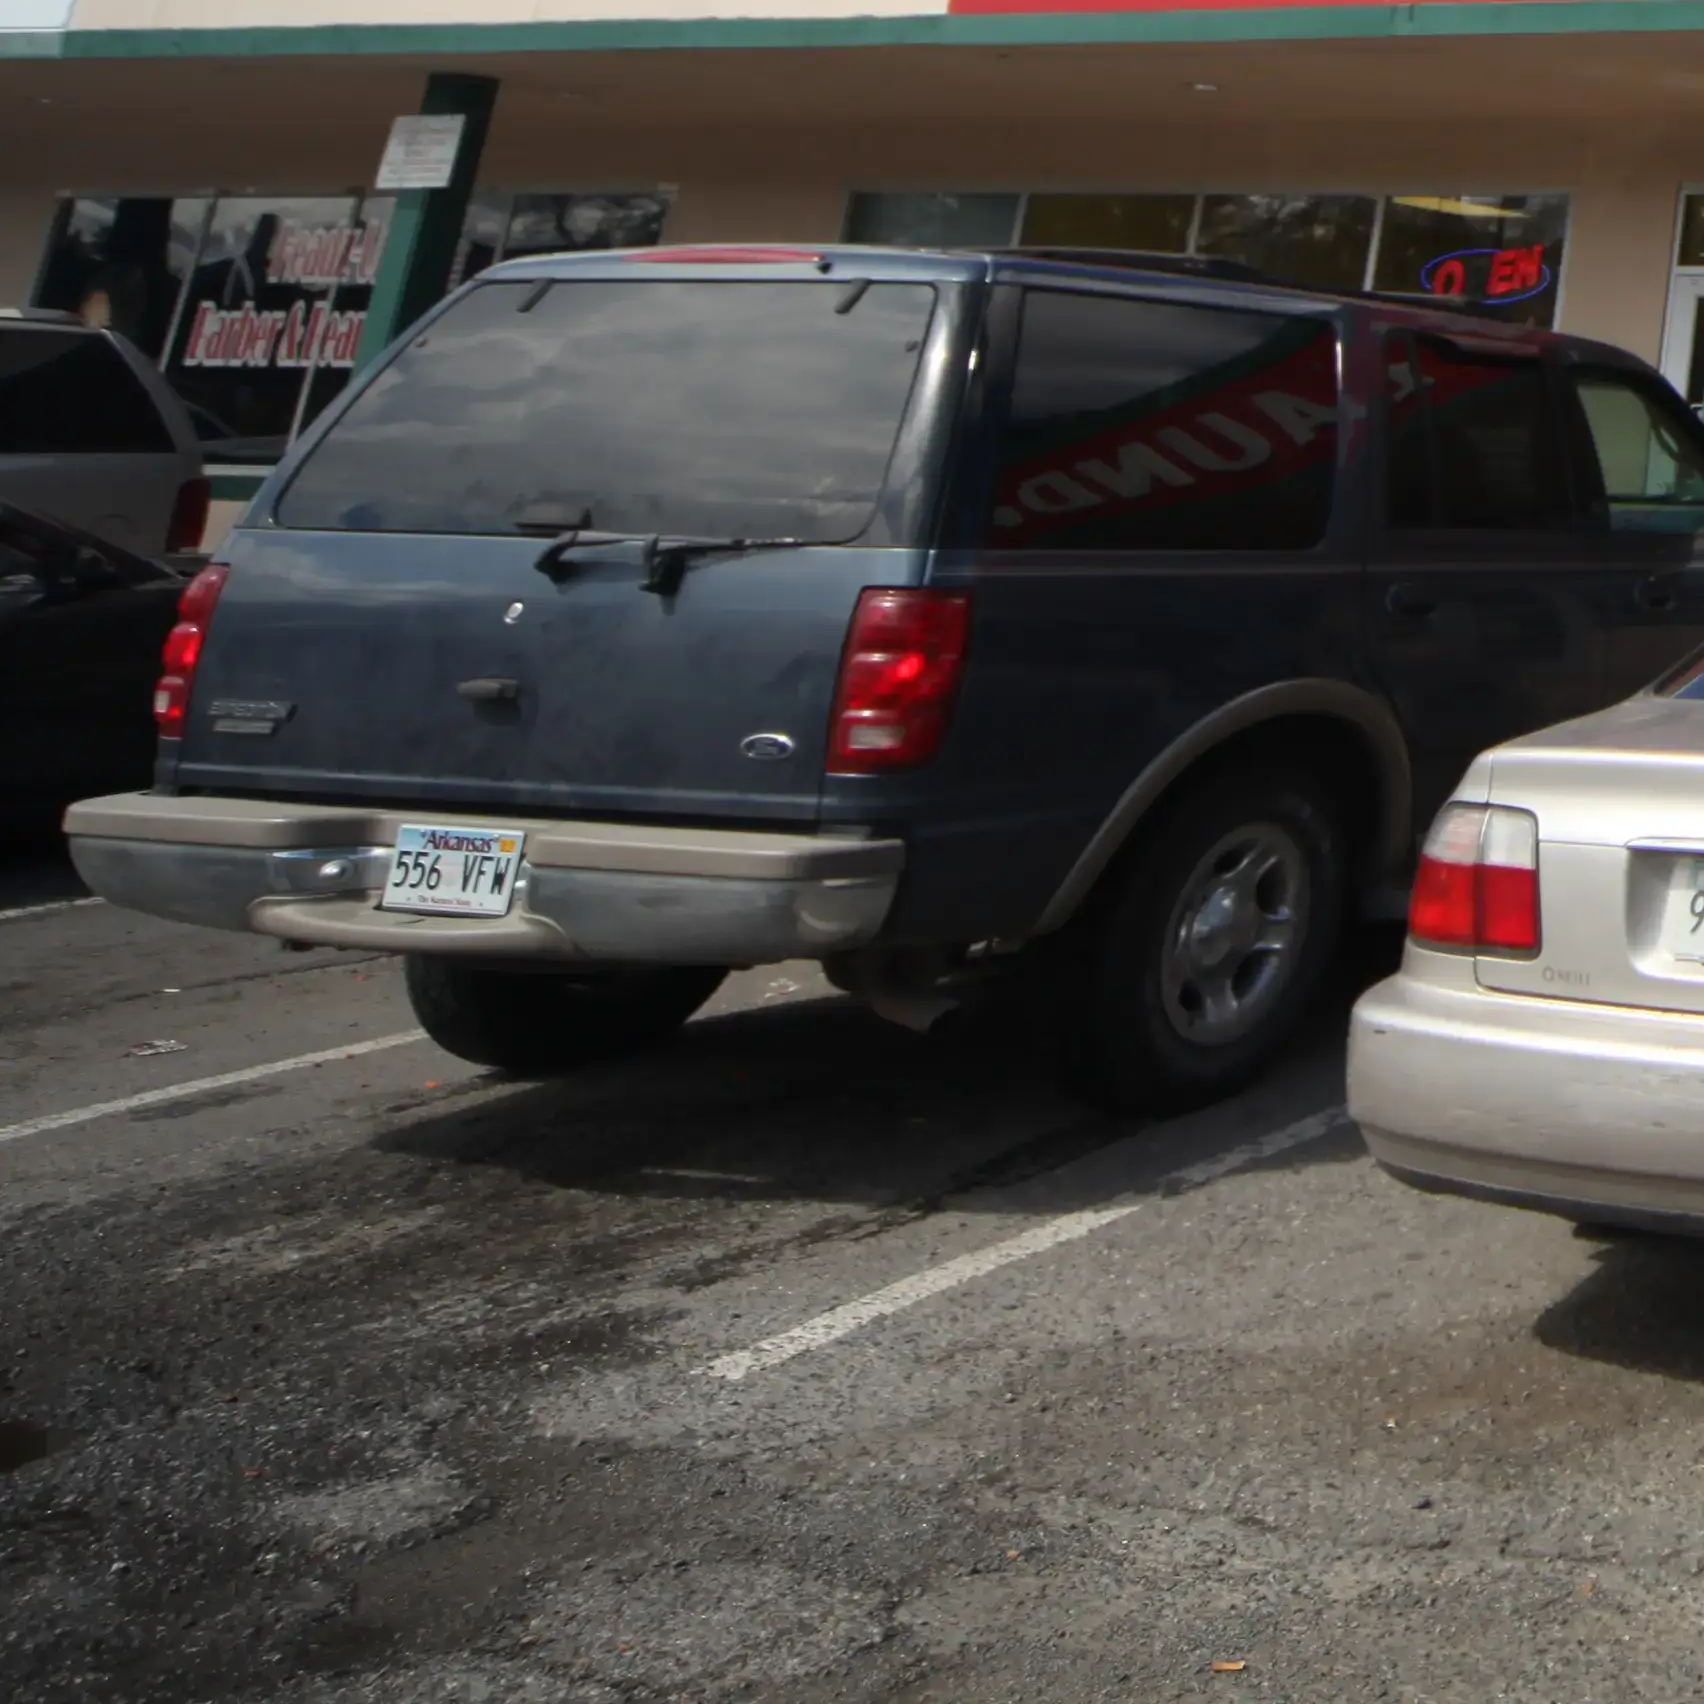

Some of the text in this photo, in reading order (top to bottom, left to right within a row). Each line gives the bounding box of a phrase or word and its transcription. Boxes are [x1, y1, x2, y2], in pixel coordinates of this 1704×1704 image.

[1432, 242, 1544, 295] OEN
[424, 830, 494, 853] Arkansas
[392, 851, 512, 895] 556 VFW
